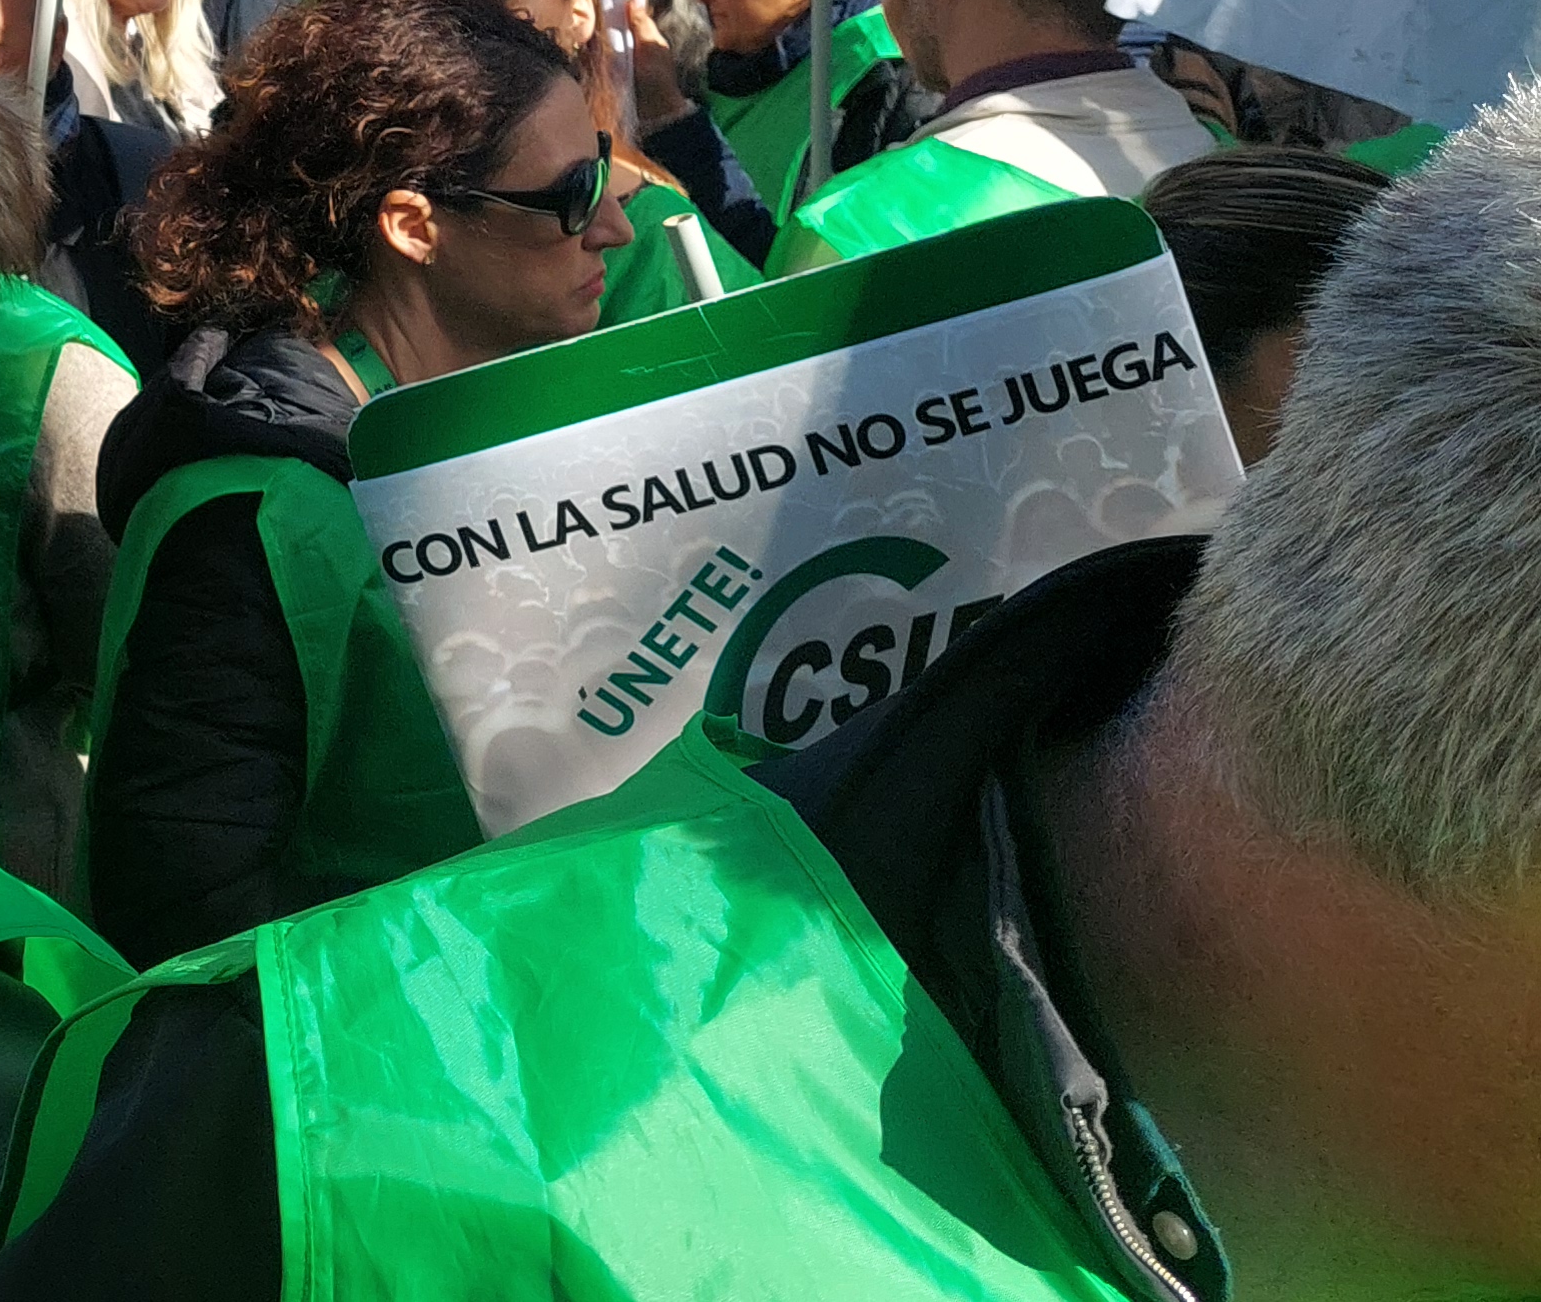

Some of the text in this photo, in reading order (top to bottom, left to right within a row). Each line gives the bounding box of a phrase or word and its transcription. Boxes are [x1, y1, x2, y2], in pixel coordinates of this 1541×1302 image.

[381, 330, 1197, 584] CON LA SALUD NO SE JUEGA
[576, 545, 765, 737] ÚNETE!
